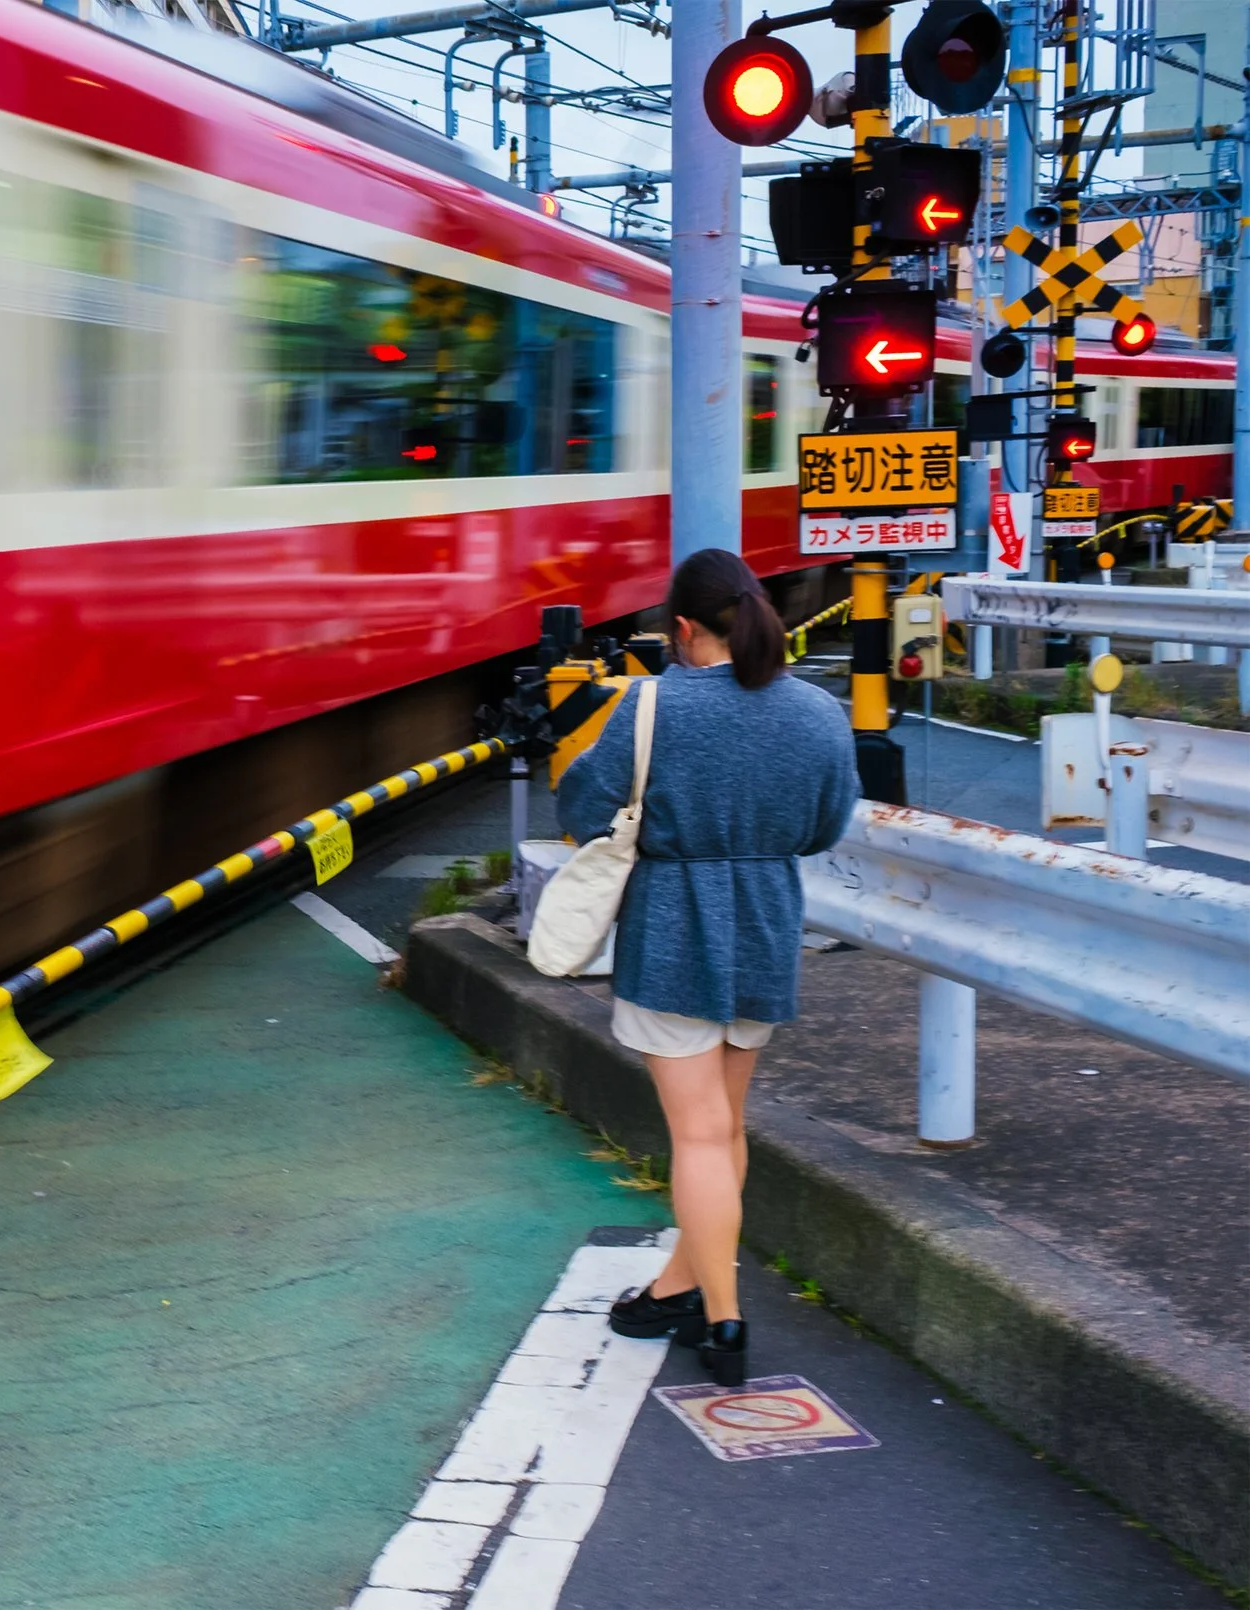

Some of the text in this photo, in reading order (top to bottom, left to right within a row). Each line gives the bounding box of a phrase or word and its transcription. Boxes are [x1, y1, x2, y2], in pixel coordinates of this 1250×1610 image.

[801, 442, 956, 495] 踏切注意
[809, 520, 948, 546] カメラ監視中
